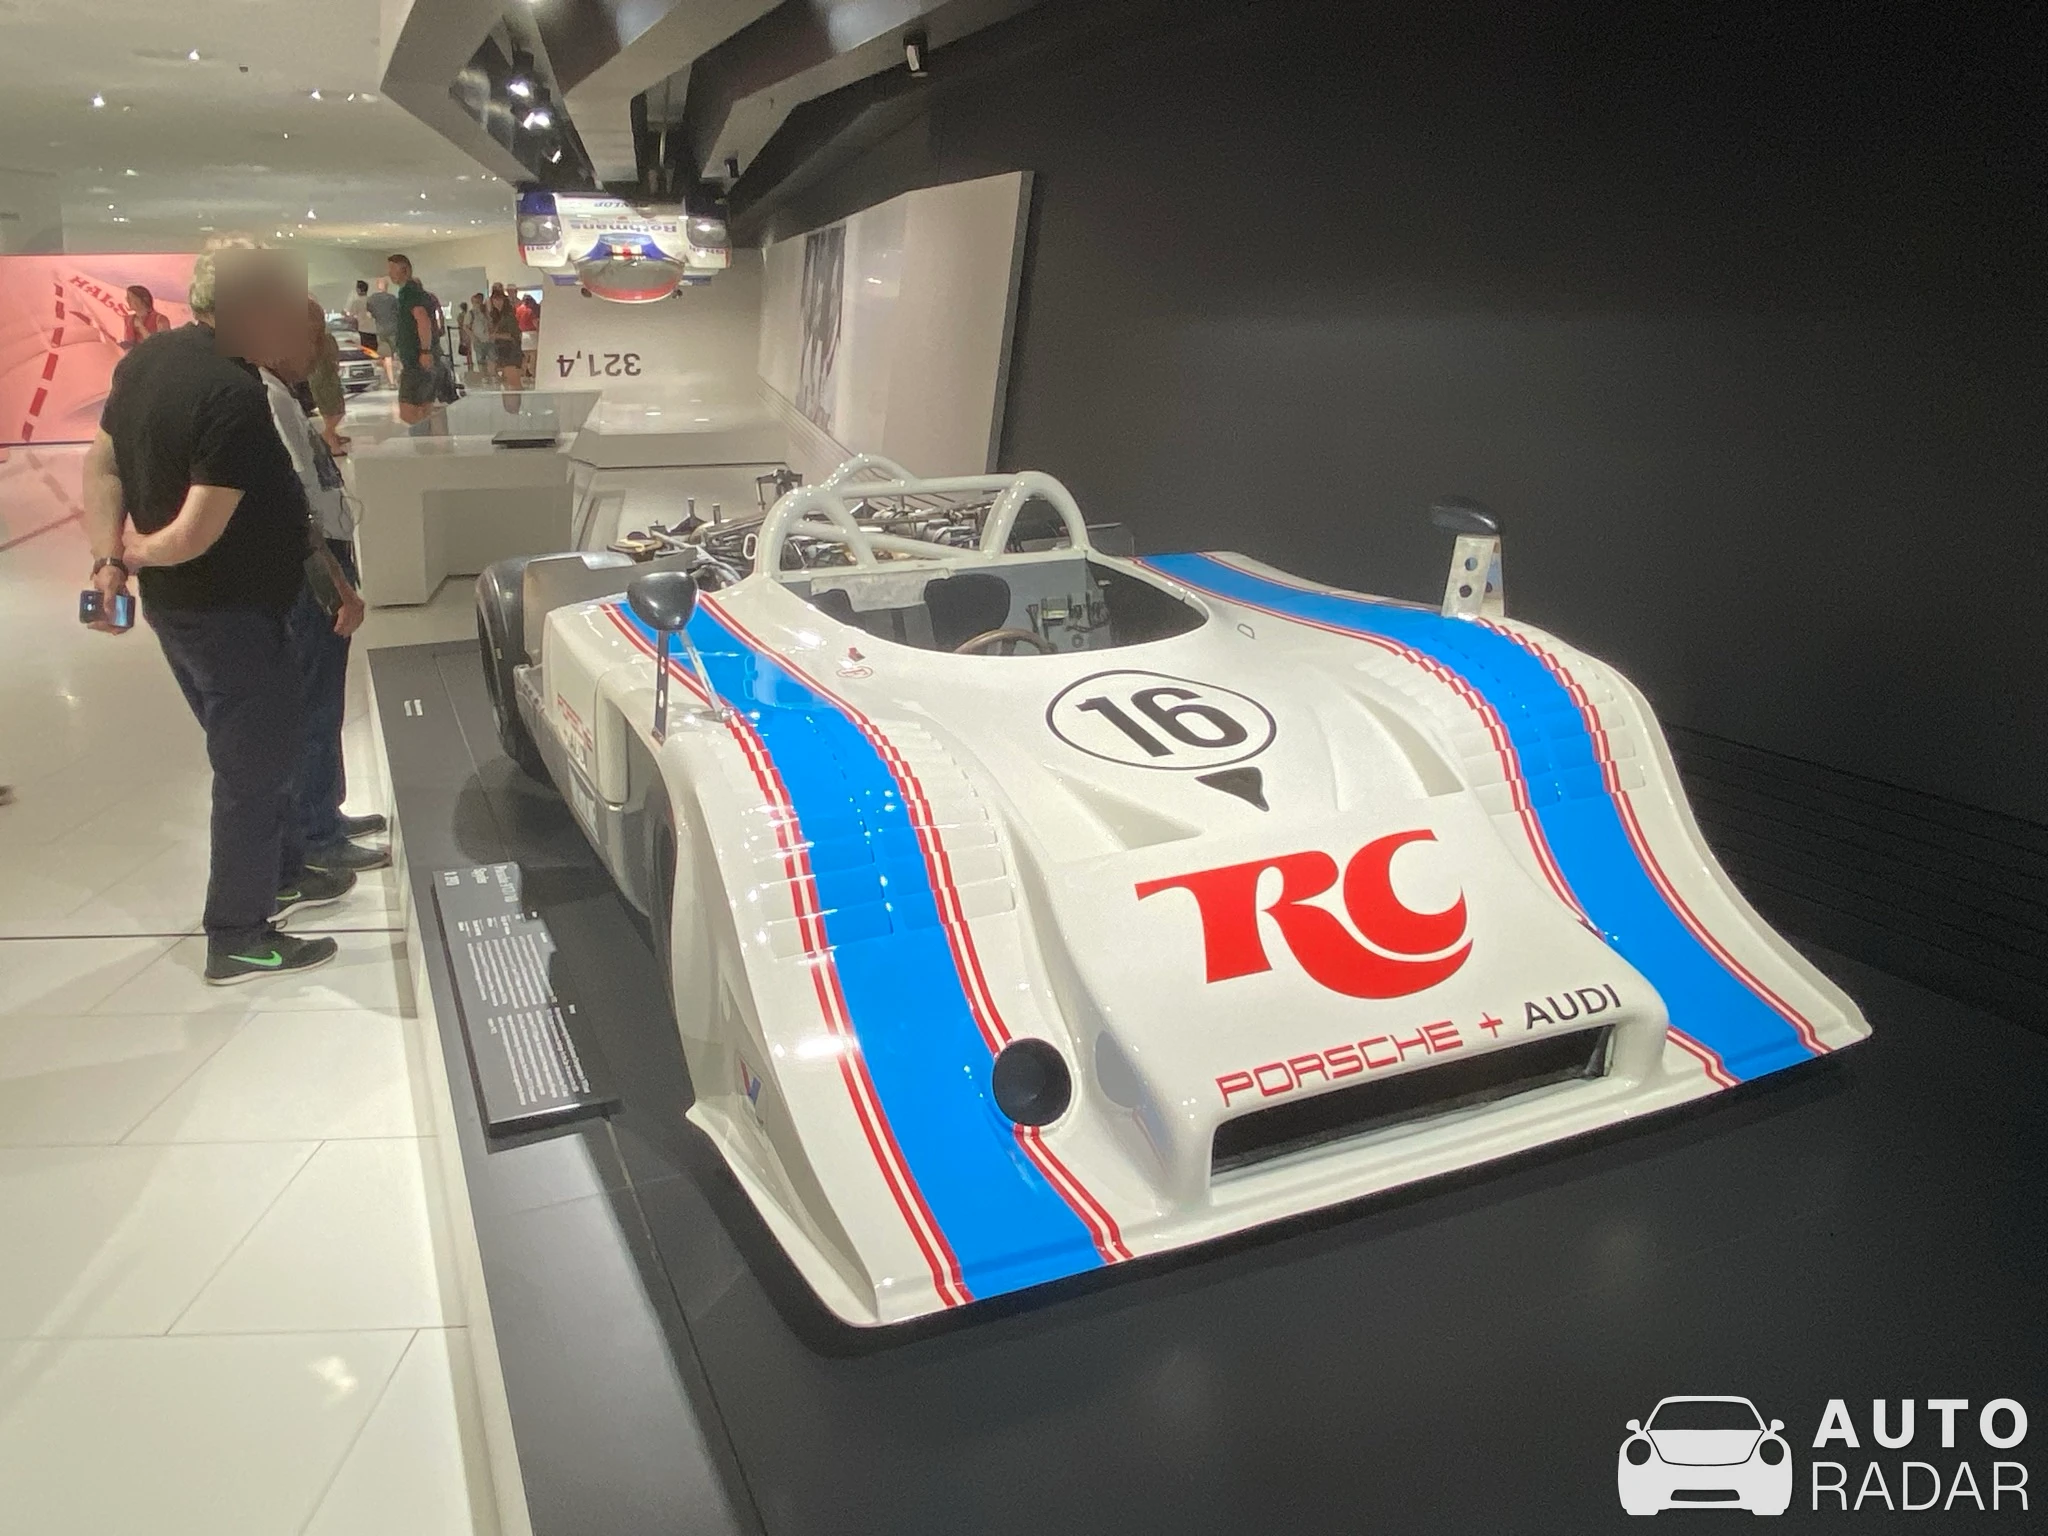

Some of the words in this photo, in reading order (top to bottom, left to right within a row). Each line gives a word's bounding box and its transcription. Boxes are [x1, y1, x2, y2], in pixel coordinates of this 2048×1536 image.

[570, 222, 678, 232] Rothmans
[556, 351, 641, 377] 321,4
[1076, 688, 1247, 757] 16
[1134, 829, 1474, 999] RC
[1215, 1021, 1464, 1107] PORSCHE
[1479, 1012, 1503, 1038] +
[1525, 983, 1622, 1029] AUDI
